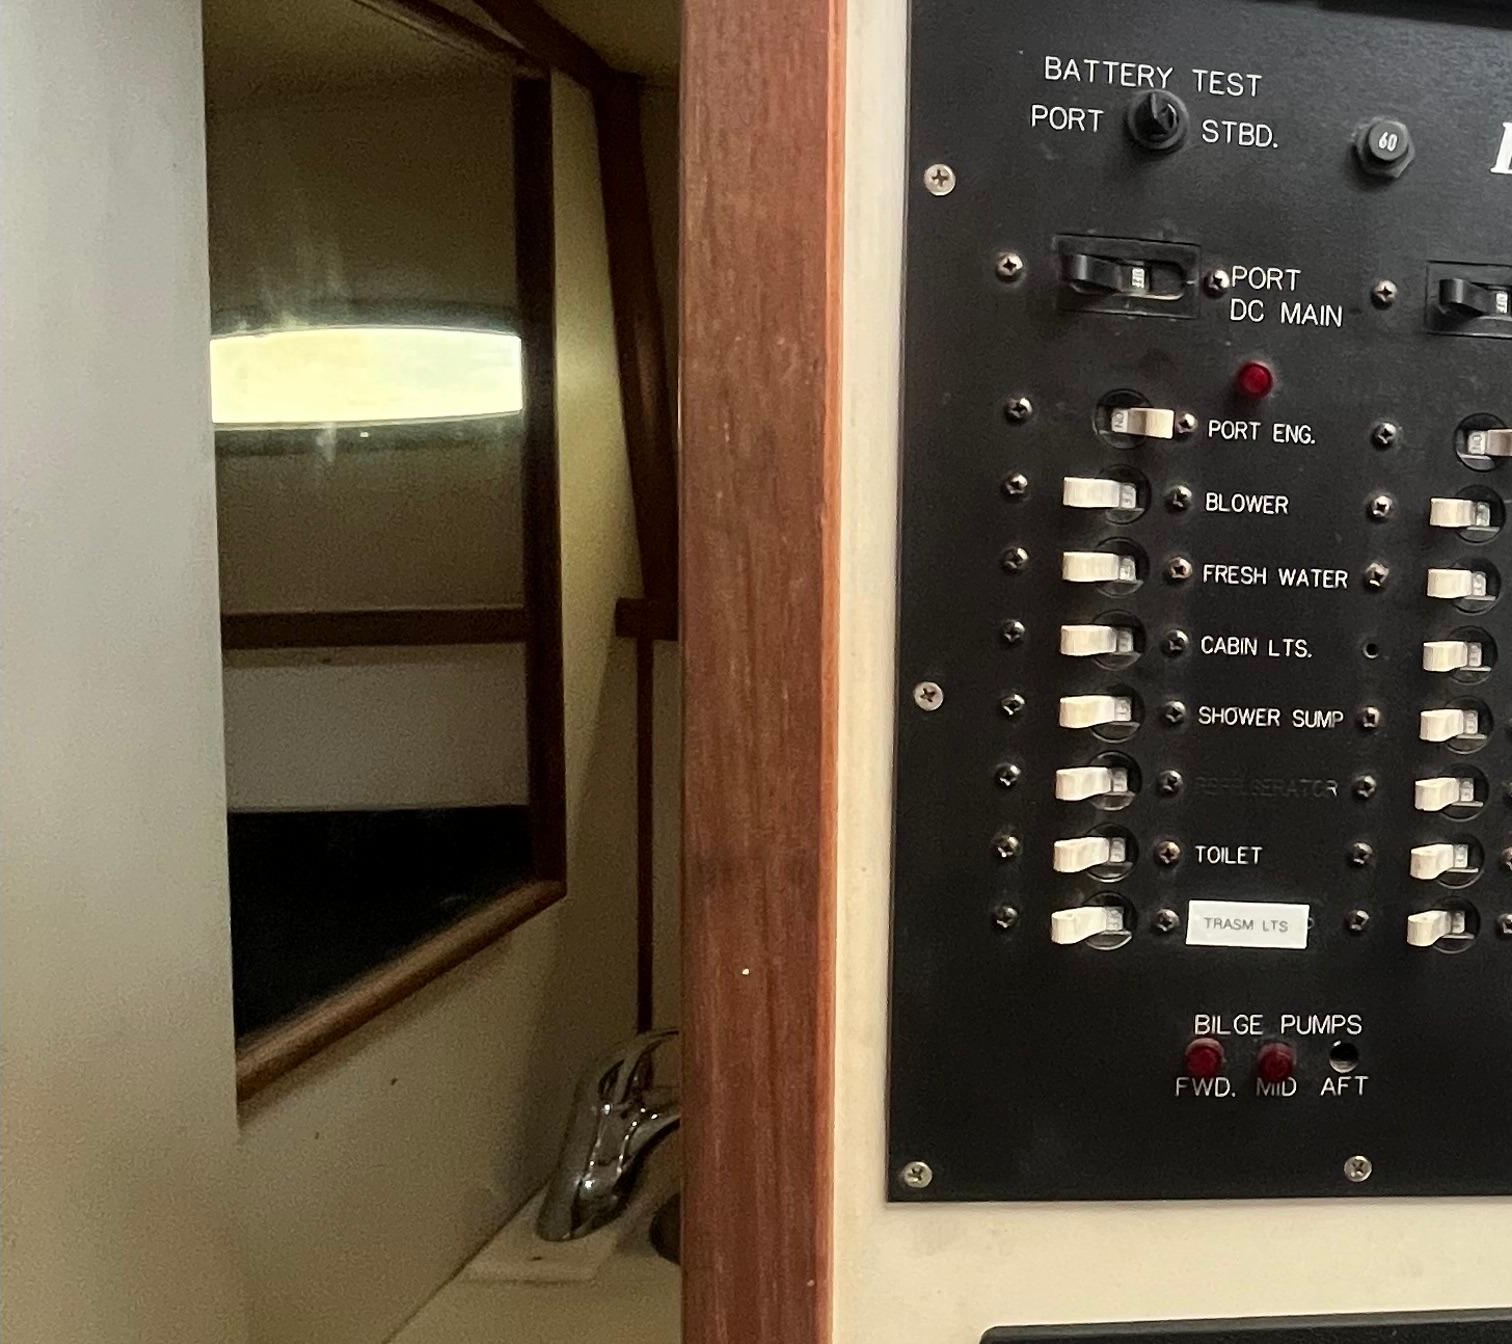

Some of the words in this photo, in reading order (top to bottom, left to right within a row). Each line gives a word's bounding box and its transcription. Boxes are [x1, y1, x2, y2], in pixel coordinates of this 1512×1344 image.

[1044, 55, 1173, 90] BATTERY
[1192, 68, 1263, 97] TEST
[1030, 104, 1104, 133] PORT
[1201, 119, 1279, 149] STBD.
[1377, 131, 1399, 152] 60
[1230, 265, 1302, 292] PORT
[1229, 298, 1265, 323] DC
[1280, 302, 1343, 328] MAIN
[1208, 419, 1261, 441] PORT
[1272, 424, 1316, 445] ENG.
[1205, 492, 1289, 515] BLOWER
[1202, 563, 1267, 586] FRESH
[1278, 567, 1349, 589] WATER
[1201, 635, 1258, 656] CABIN
[1268, 638, 1313, 658] LTS.
[1198, 706, 1281, 727] SHOWER
[1291, 709, 1344, 729] SUMP
[1195, 845, 1263, 866] TOILET
[1204, 916, 1254, 931] TRASM
[1262, 918, 1289, 933] LTS
[1194, 1013, 1264, 1036] BILGE
[1280, 1013, 1363, 1036] PUMPS
[1174, 1076, 1237, 1099] FWD.
[1255, 1076, 1297, 1098] MID
[1320, 1075, 1370, 1097] AFT
